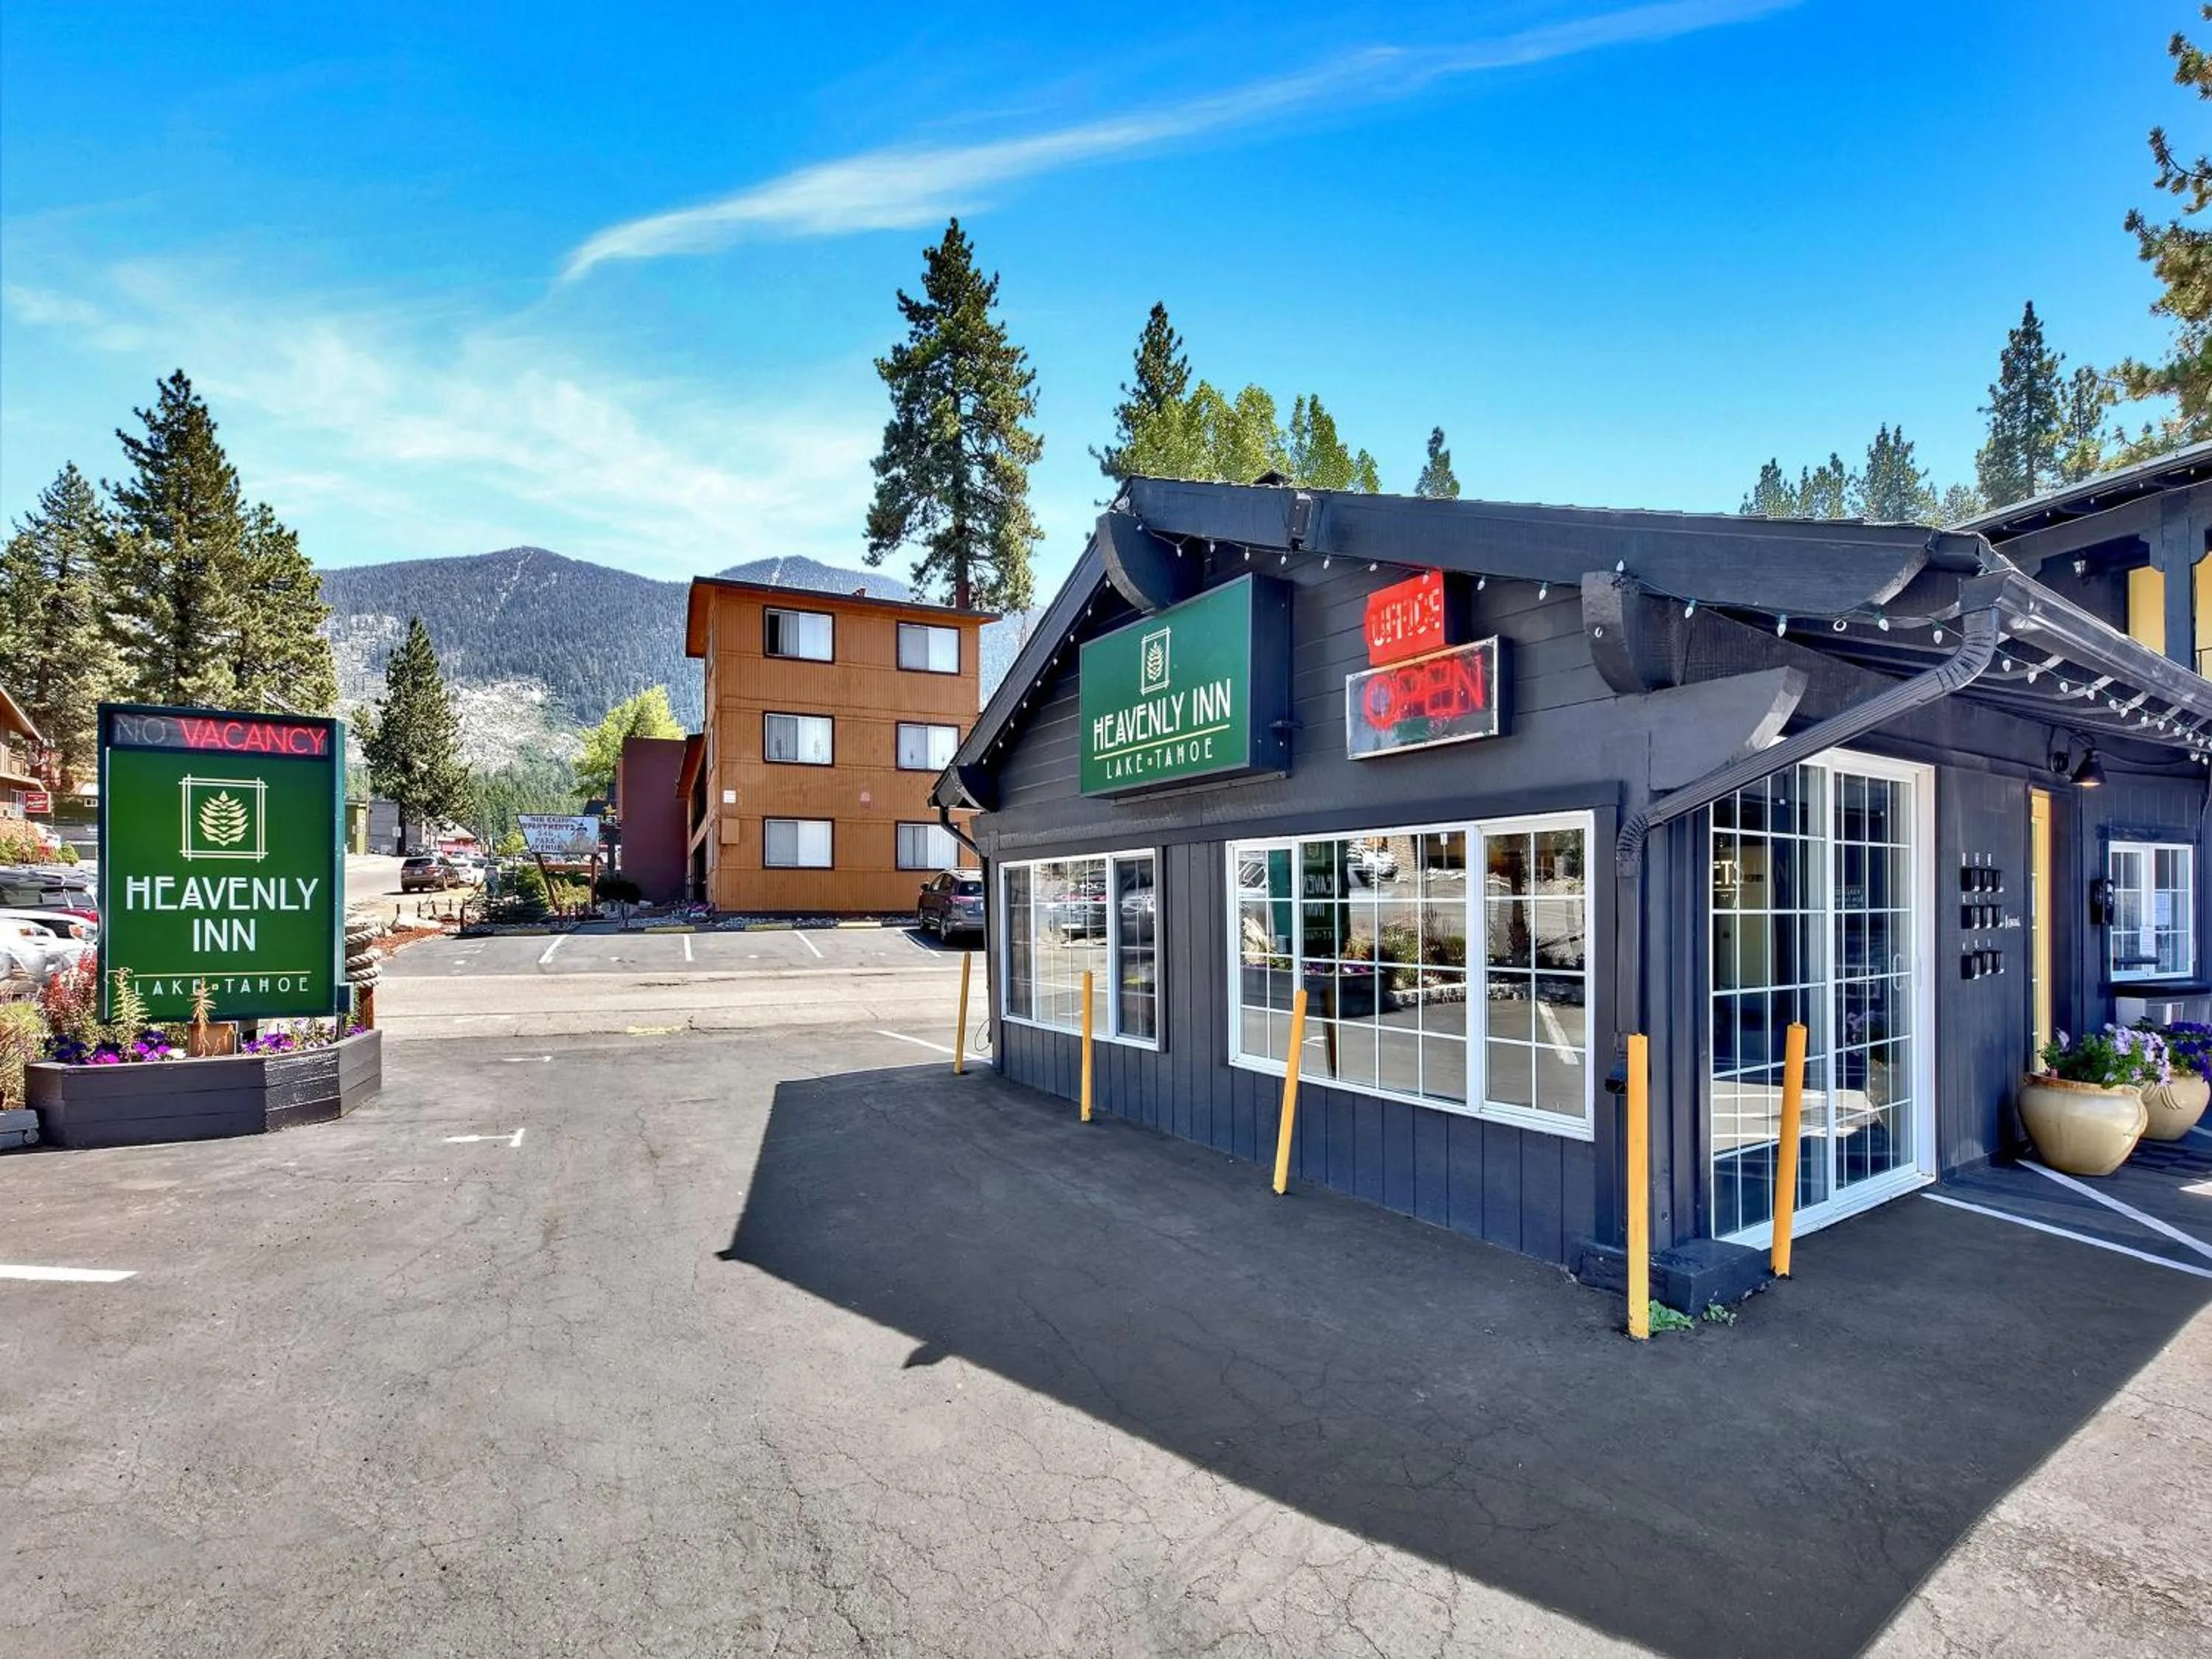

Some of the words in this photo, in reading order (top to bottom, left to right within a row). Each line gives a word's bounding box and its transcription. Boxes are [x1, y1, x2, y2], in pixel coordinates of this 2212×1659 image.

[1363, 654, 1484, 731] OPEN
[1093, 692, 1185, 752] HEAVENLY
[1192, 678, 1231, 726] INN
[116, 717, 167, 745] NO
[180, 718, 327, 755] VACANCY
[1107, 753, 1144, 779] LAKE
[1155, 737, 1213, 769] TAHOE
[126, 875, 319, 911] HEAVENLY
[192, 919, 256, 952] INN
[224, 977, 309, 993] TAHOE
